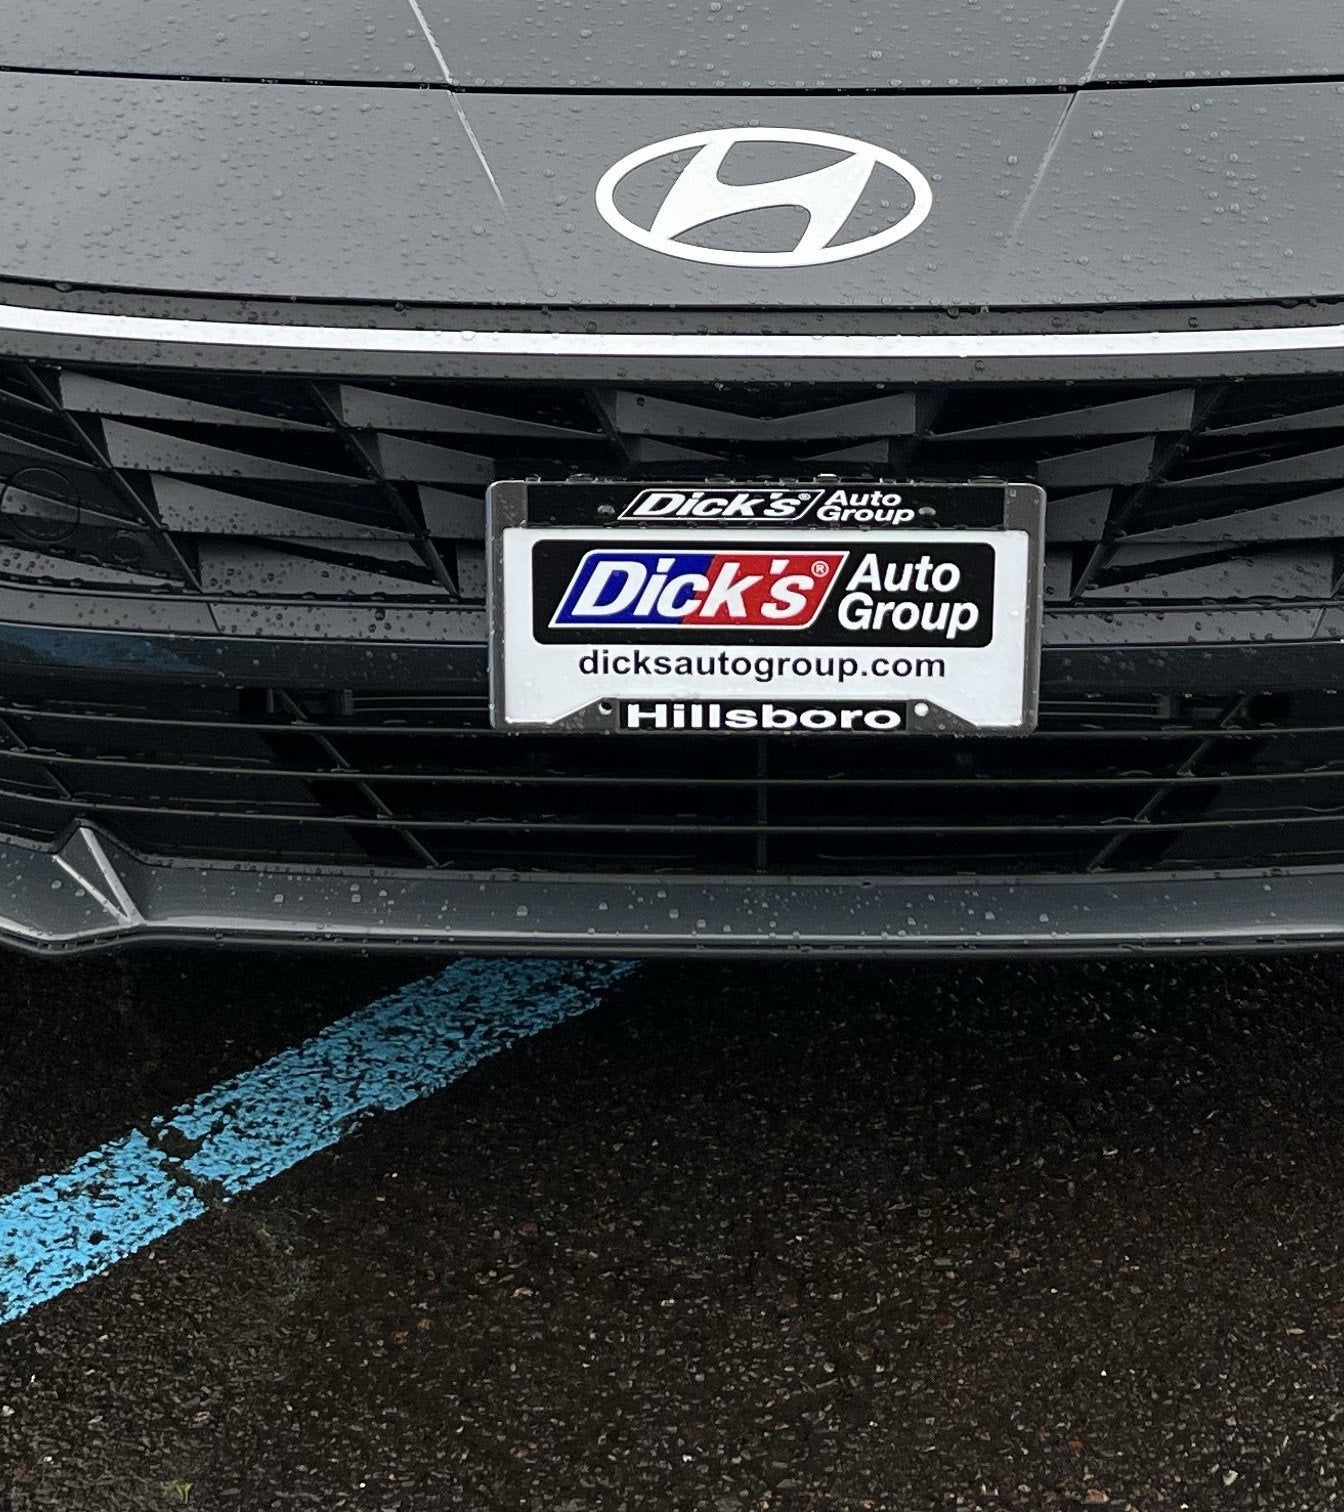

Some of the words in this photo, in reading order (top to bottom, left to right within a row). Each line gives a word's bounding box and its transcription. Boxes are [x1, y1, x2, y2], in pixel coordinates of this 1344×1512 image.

[632, 492, 802, 516] Dick's
[824, 490, 902, 506] Auto
[816, 506, 916, 525] Group
[571, 557, 813, 618] Dick's
[846, 553, 961, 592] Auto
[837, 592, 979, 638] Group
[579, 650, 945, 683] dicksautogroup.com
[626, 703, 902, 730] Hillsboro
